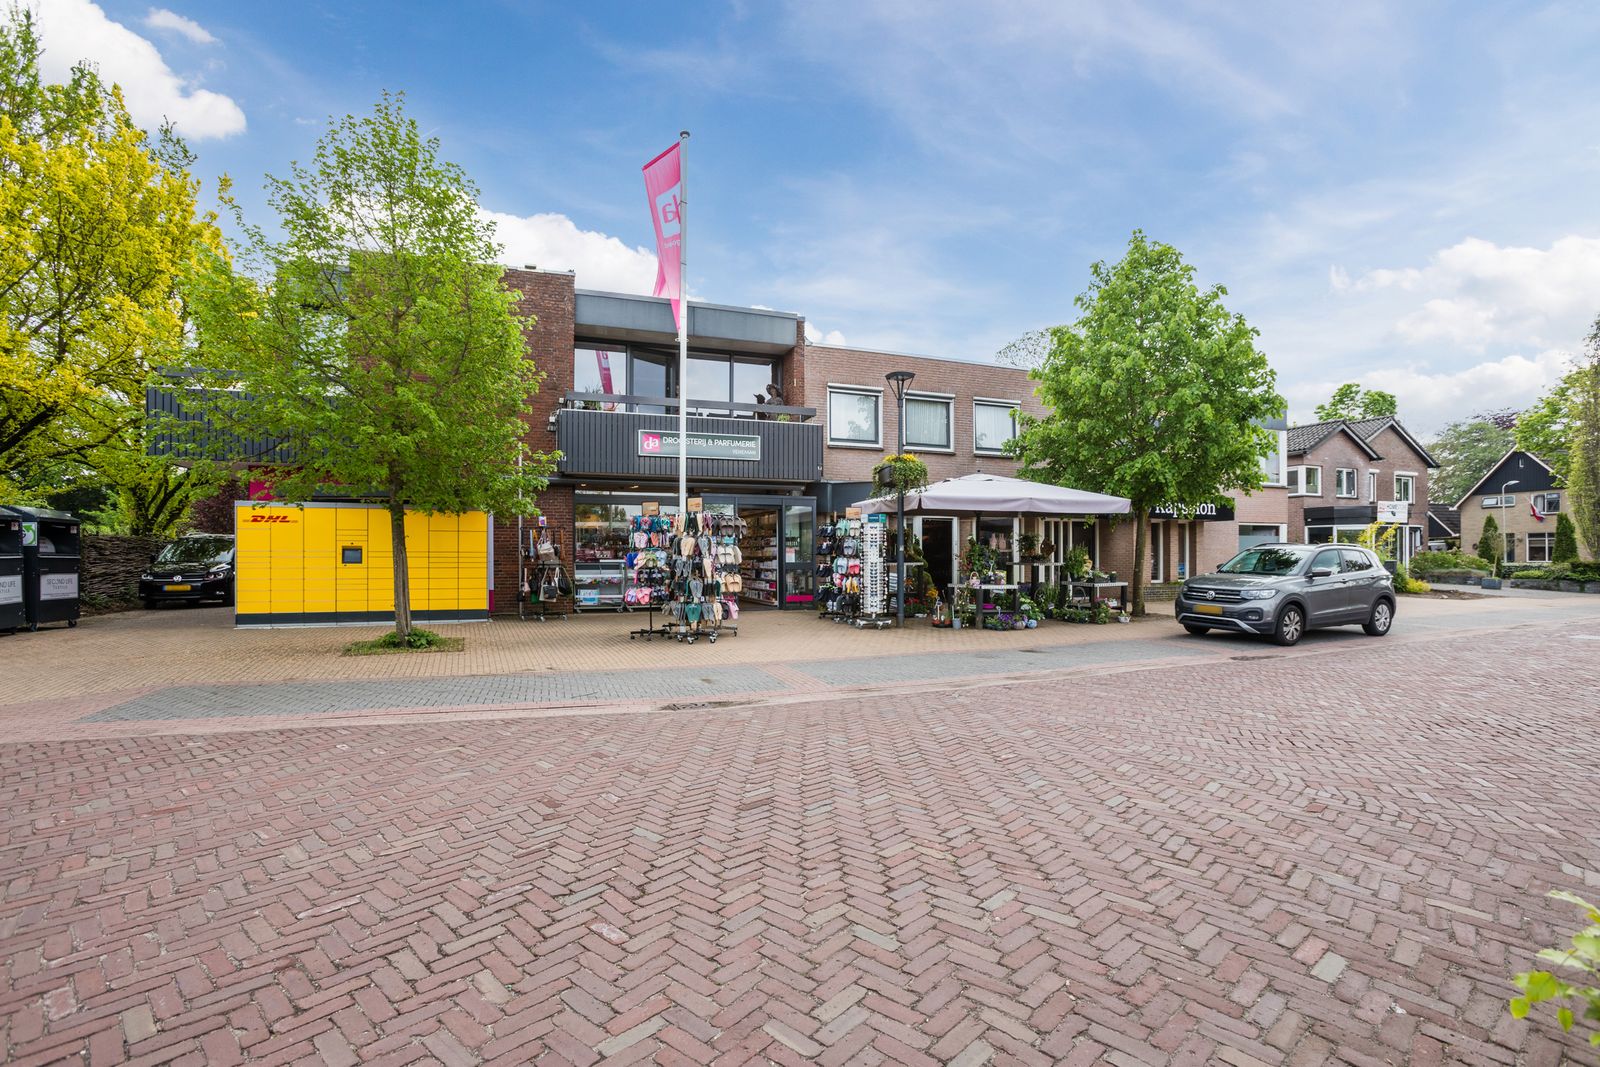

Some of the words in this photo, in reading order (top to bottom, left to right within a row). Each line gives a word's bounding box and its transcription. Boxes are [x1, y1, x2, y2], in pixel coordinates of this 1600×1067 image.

[643, 437, 659, 450] da
[662, 436, 707, 447] DROSTERIJ
[708, 438, 714, 446] &
[714, 439, 756, 448] PARFUMERIE
[250, 515, 290, 523] DHL
